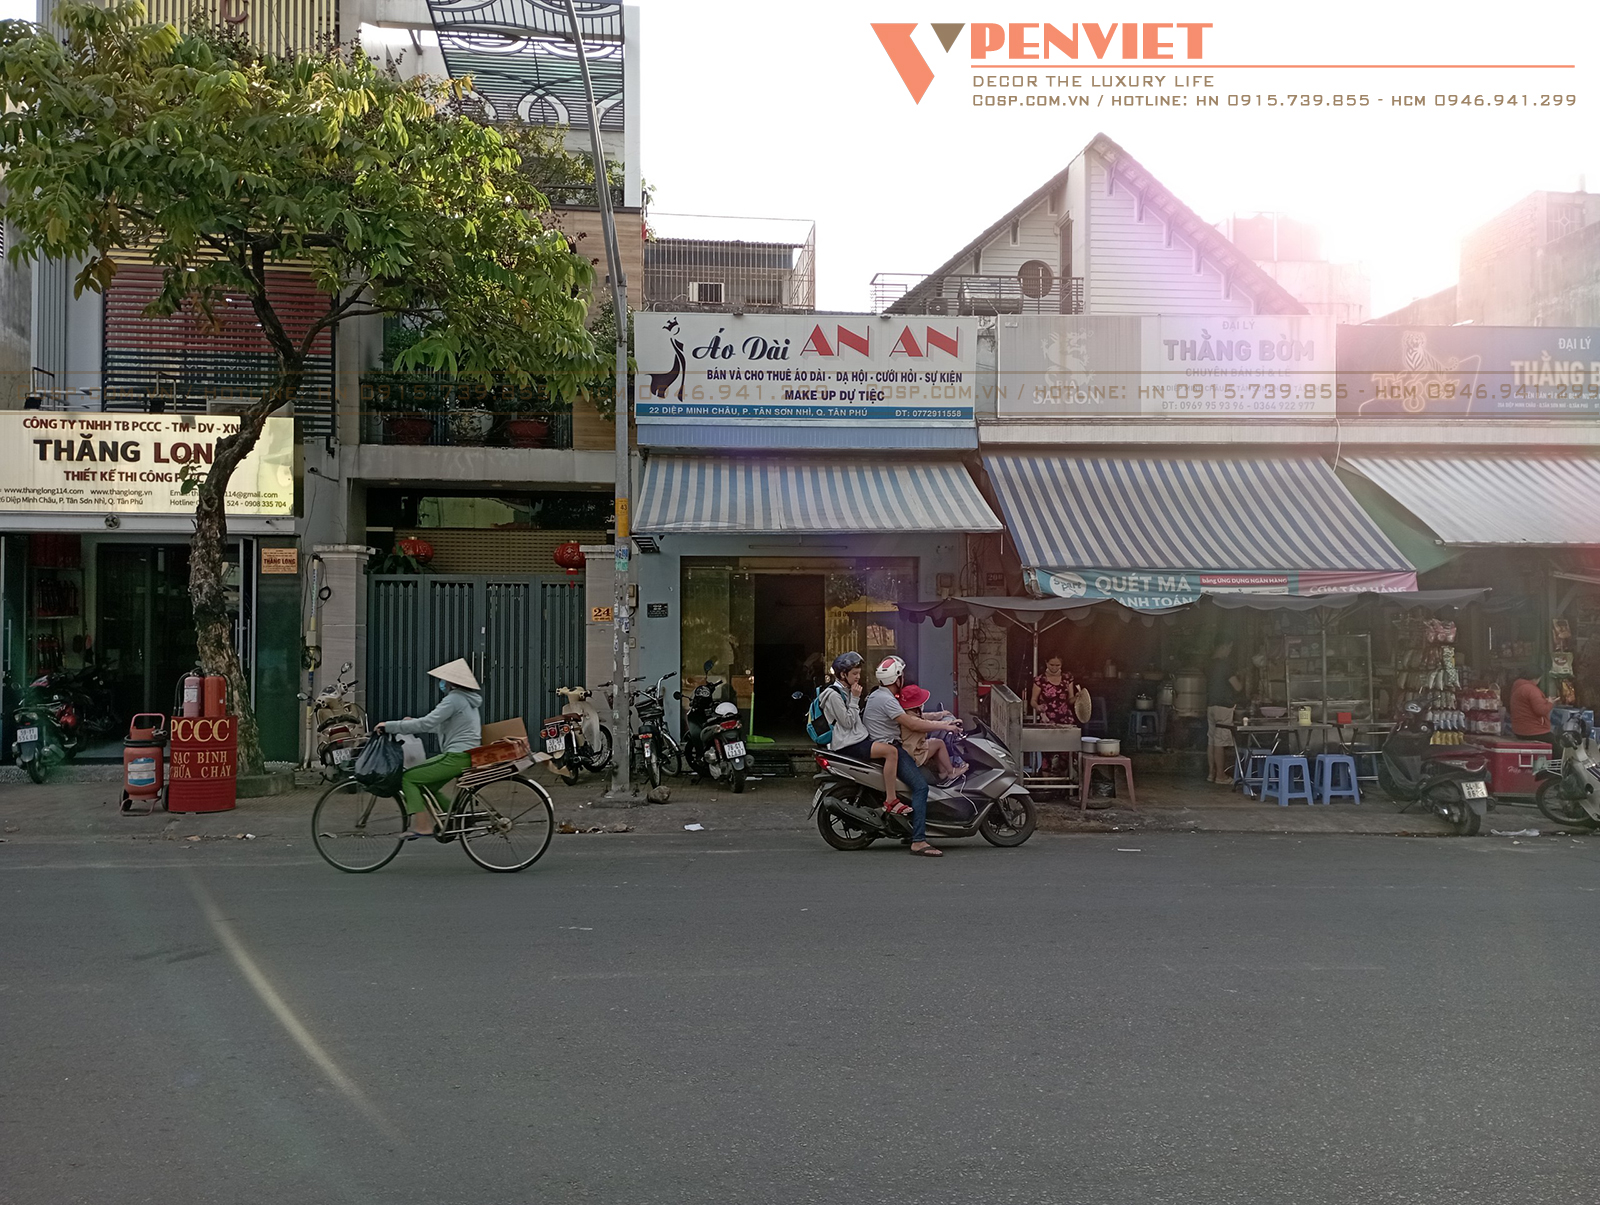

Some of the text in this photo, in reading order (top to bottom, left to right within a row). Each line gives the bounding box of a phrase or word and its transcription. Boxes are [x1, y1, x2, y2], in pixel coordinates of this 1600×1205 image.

[1241, 318, 1255, 330] LÝ
[691, 323, 959, 361] Áo Dài AN AN
[1163, 328, 1315, 361] THẰNG BỜM
[1558, 336, 1592, 352] ĐẠI LÝ
[1510, 350, 1585, 386] THẰNG
[707, 368, 963, 386] BÁN VÀ CHO THUÊ ÁO DÀI DẠ HỘI CƯỚI HỎI SỰ KIỆN
[785, 389, 885, 404] MAKE UP DỰ TIỆC
[649, 405, 962, 418] 22 DIỆP MINH CHÂU, P. TÂN SƠN NHÌ, Q. TÂN PHÚ ĐT: 0772911558
[1180, 401, 1202, 410] 0969
[1205, 401, 1217, 410] 95
[1219, 401, 1230, 410] 93
[1232, 401, 1244, 410] 96
[1253, 401, 1276, 410] 0364
[1279, 401, 1295, 410] 922
[1298, 401, 1315, 410] 977
[23, 417, 241, 434] CÔNG TY TNHH TB PCCC TM DV XN
[33, 433, 214, 465] THĂNG LON
[64, 467, 97, 482] THIẾT
[100, 468, 115, 482] KẾ
[118, 471, 138, 483] THI
[140, 469, 172, 483] CÔNG
[1095, 573, 1152, 596] QUÉT
[594, 607, 611, 617] 24
[171, 719, 230, 742] PCCC
[173, 750, 227, 765] SẠC BÌNH
